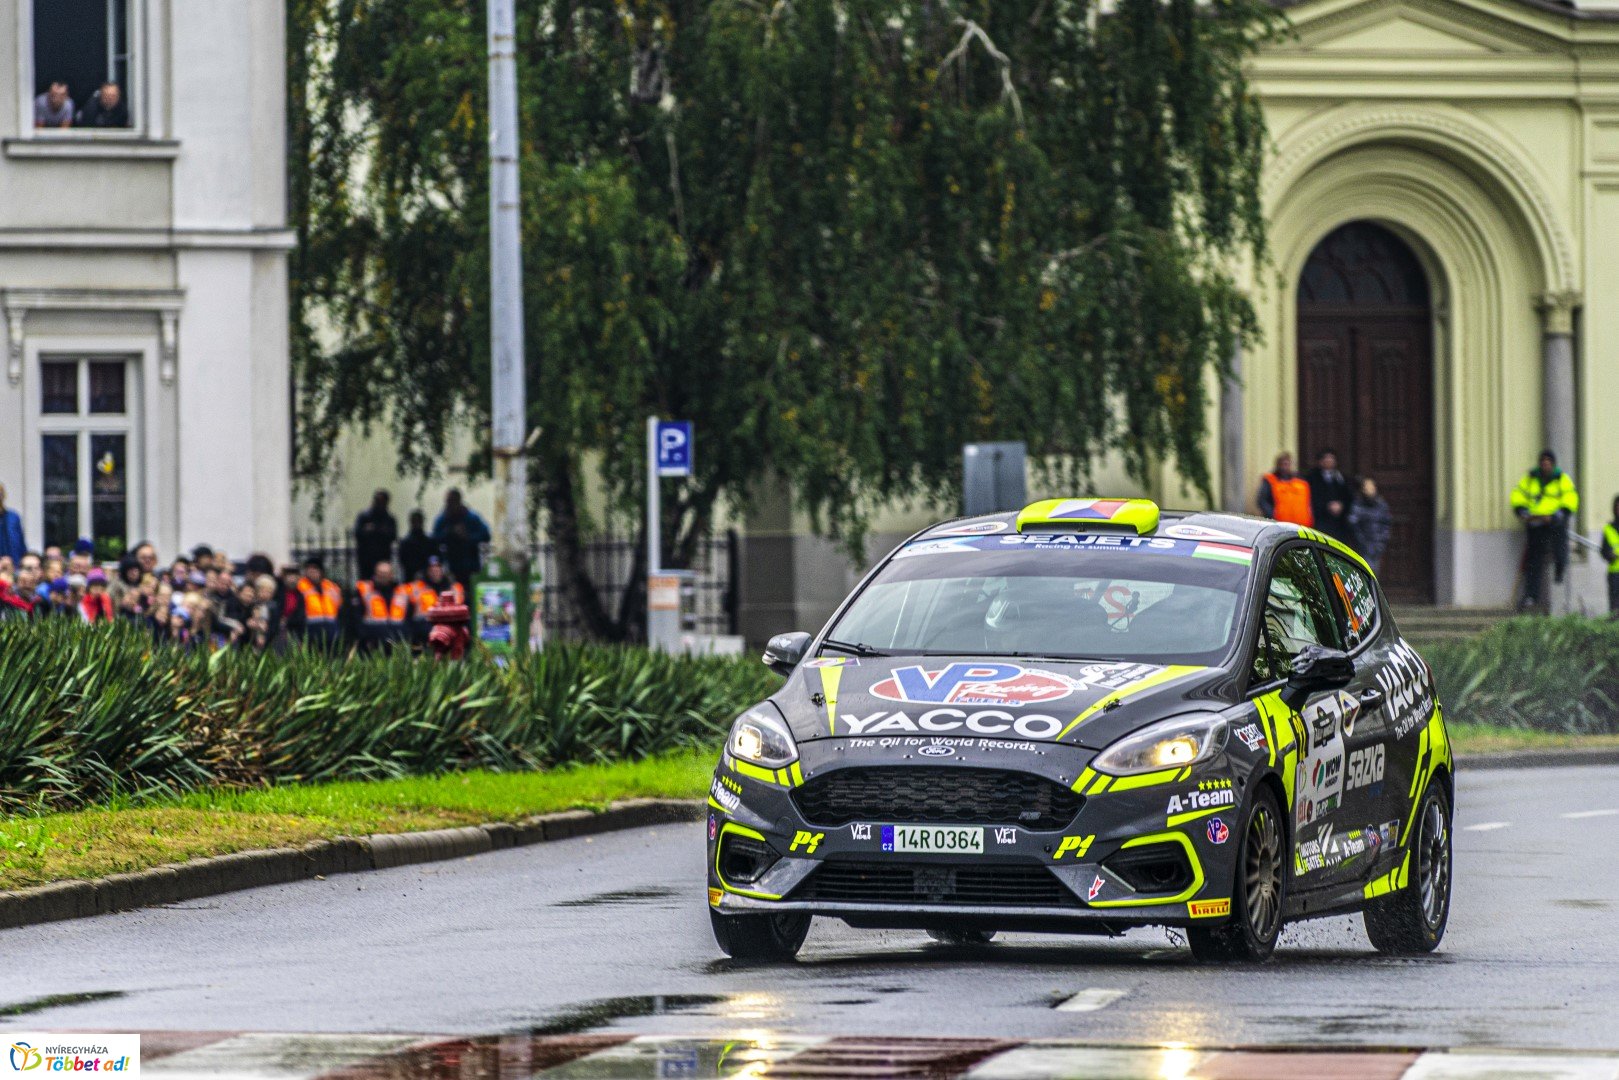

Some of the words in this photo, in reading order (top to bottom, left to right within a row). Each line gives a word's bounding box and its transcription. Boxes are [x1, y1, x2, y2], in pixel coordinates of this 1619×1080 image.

[660, 428, 686, 461] P
[1000, 534, 1175, 549] SEAJETS
[1035, 543, 1070, 551] Racing
[1074, 543, 1085, 551] to
[1087, 544, 1131, 552] summer
[892, 664, 1022, 702] VP
[960, 683, 1061, 697] Racing
[955, 696, 1021, 705] FUELS
[840, 708, 1063, 738] YACCO
[850, 737, 875, 748] The
[880, 737, 900, 748] Oil
[904, 737, 925, 746] for
[930, 737, 974, 747] World
[978, 738, 1036, 751] Records
[924, 746, 948, 755] Ford
[1167, 789, 1234, 814] A-Team
[898, 829, 931, 849] 14R
[934, 830, 981, 850] 0364
[882, 843, 893, 851] CZ
[1052, 834, 1096, 860] P1
[1191, 901, 1229, 915] PIRELLI
